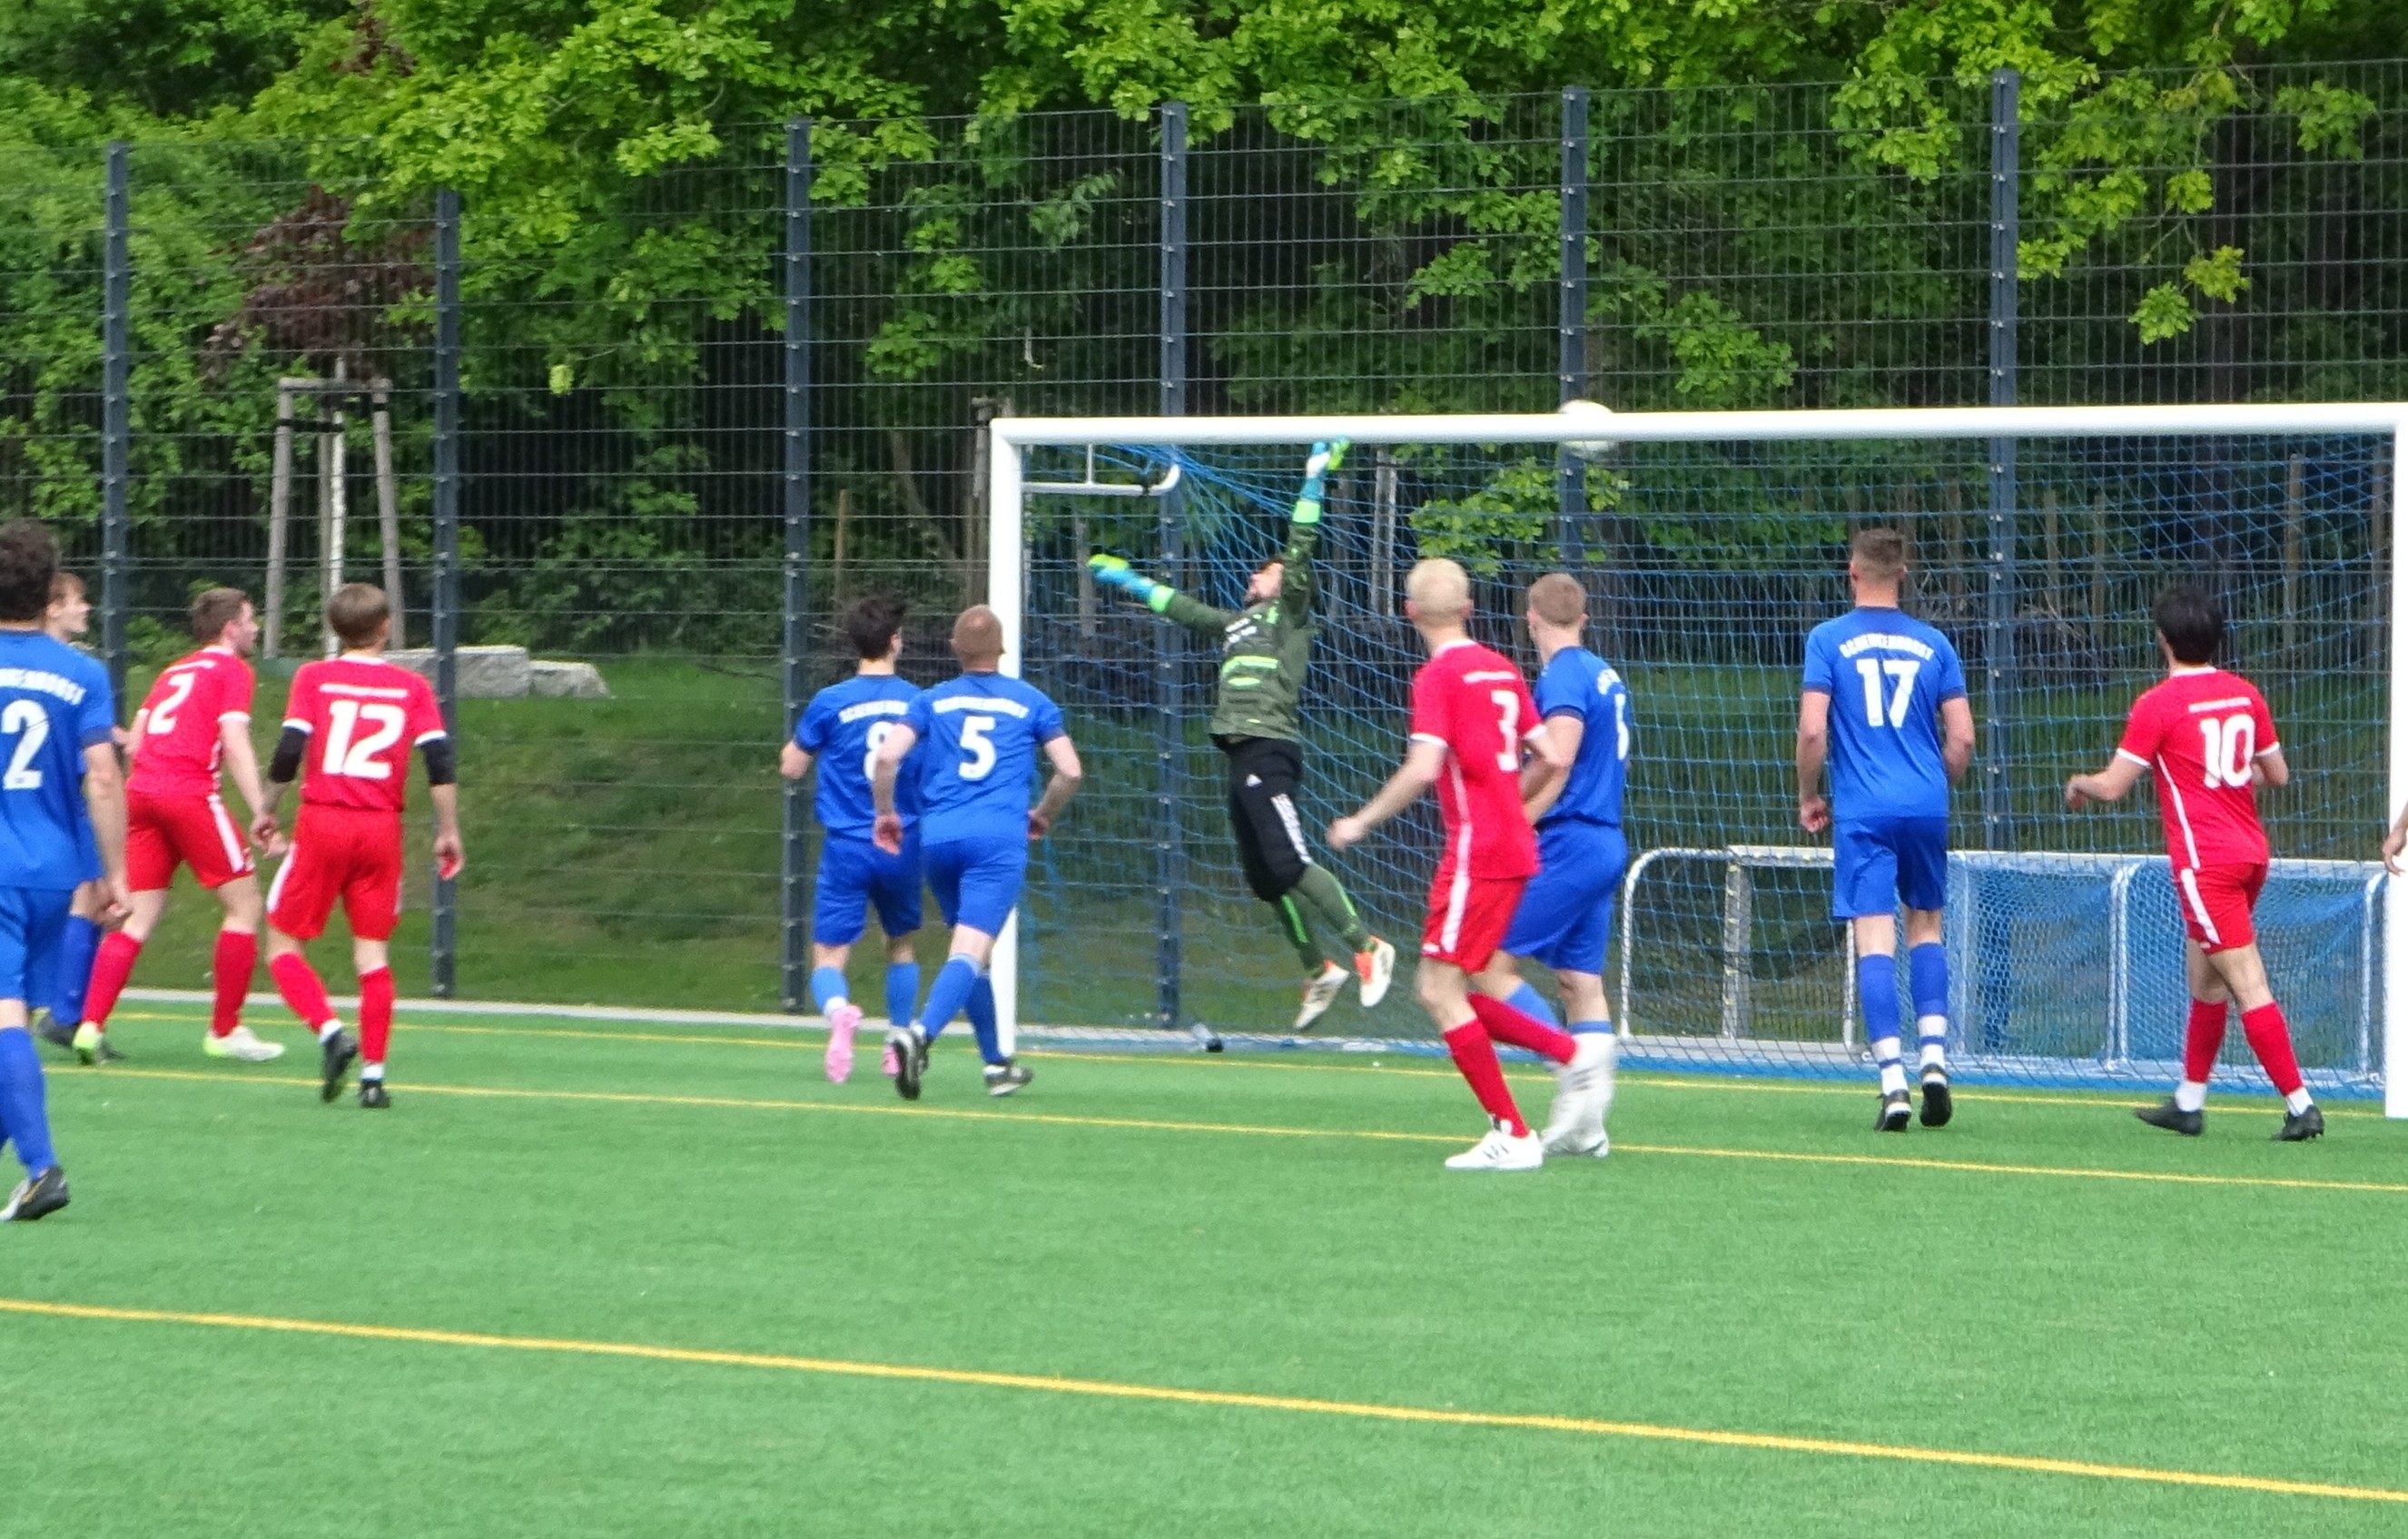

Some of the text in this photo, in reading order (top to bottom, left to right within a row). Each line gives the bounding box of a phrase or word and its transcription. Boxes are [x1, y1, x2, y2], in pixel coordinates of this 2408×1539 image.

[148, 672, 195, 735] 2
[1856, 658, 1920, 727] 17
[3, 699, 49, 789] 2
[322, 700, 406, 778] 12
[959, 715, 996, 782] 5
[1491, 690, 1519, 772] 3
[2199, 714, 2255, 789] 10
